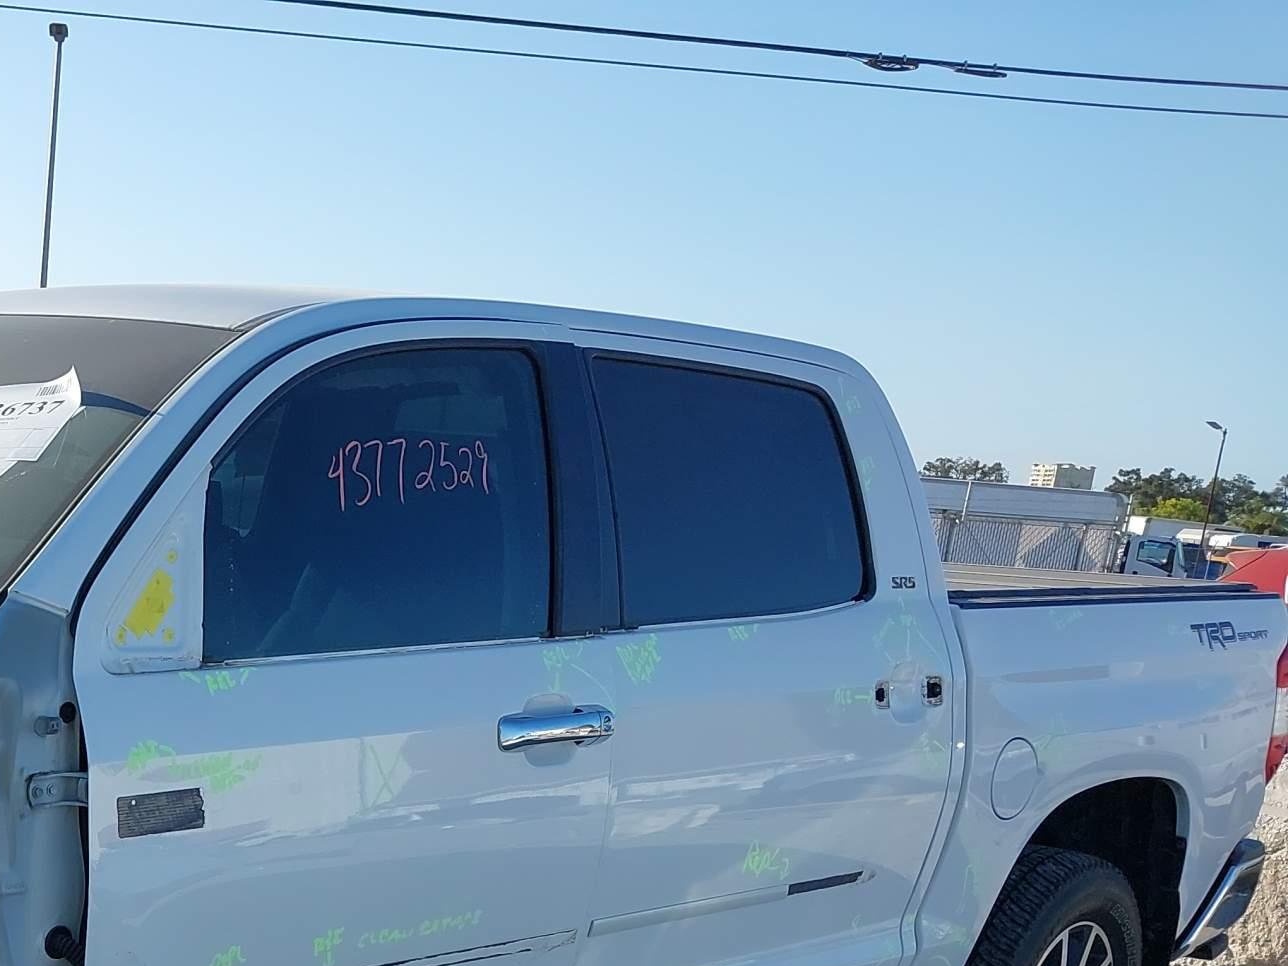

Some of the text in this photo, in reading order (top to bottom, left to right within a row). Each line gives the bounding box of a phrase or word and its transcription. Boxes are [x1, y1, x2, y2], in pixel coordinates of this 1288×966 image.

[327, 438, 491, 511] 43772529
[891, 576, 916, 589] SR5
[1190, 621, 1269, 651] TRD SPORT
